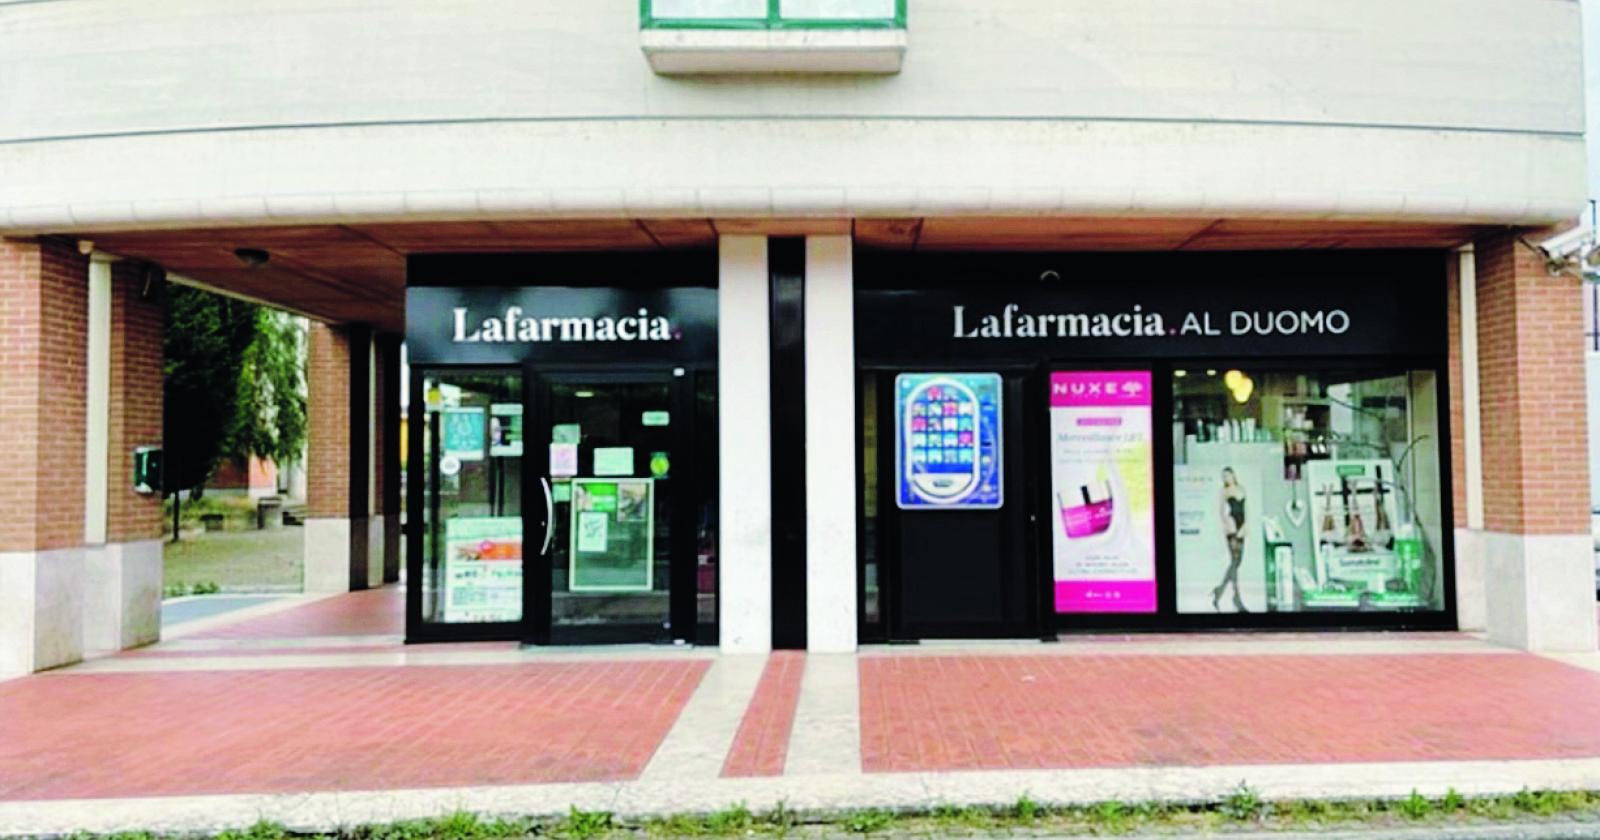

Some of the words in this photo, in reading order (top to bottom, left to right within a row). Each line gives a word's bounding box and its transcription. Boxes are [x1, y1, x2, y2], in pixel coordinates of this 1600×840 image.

[1180, 312, 1221, 335] AL
[1231, 310, 1350, 335] DUOMO
[1053, 382, 1117, 395] NUXE
